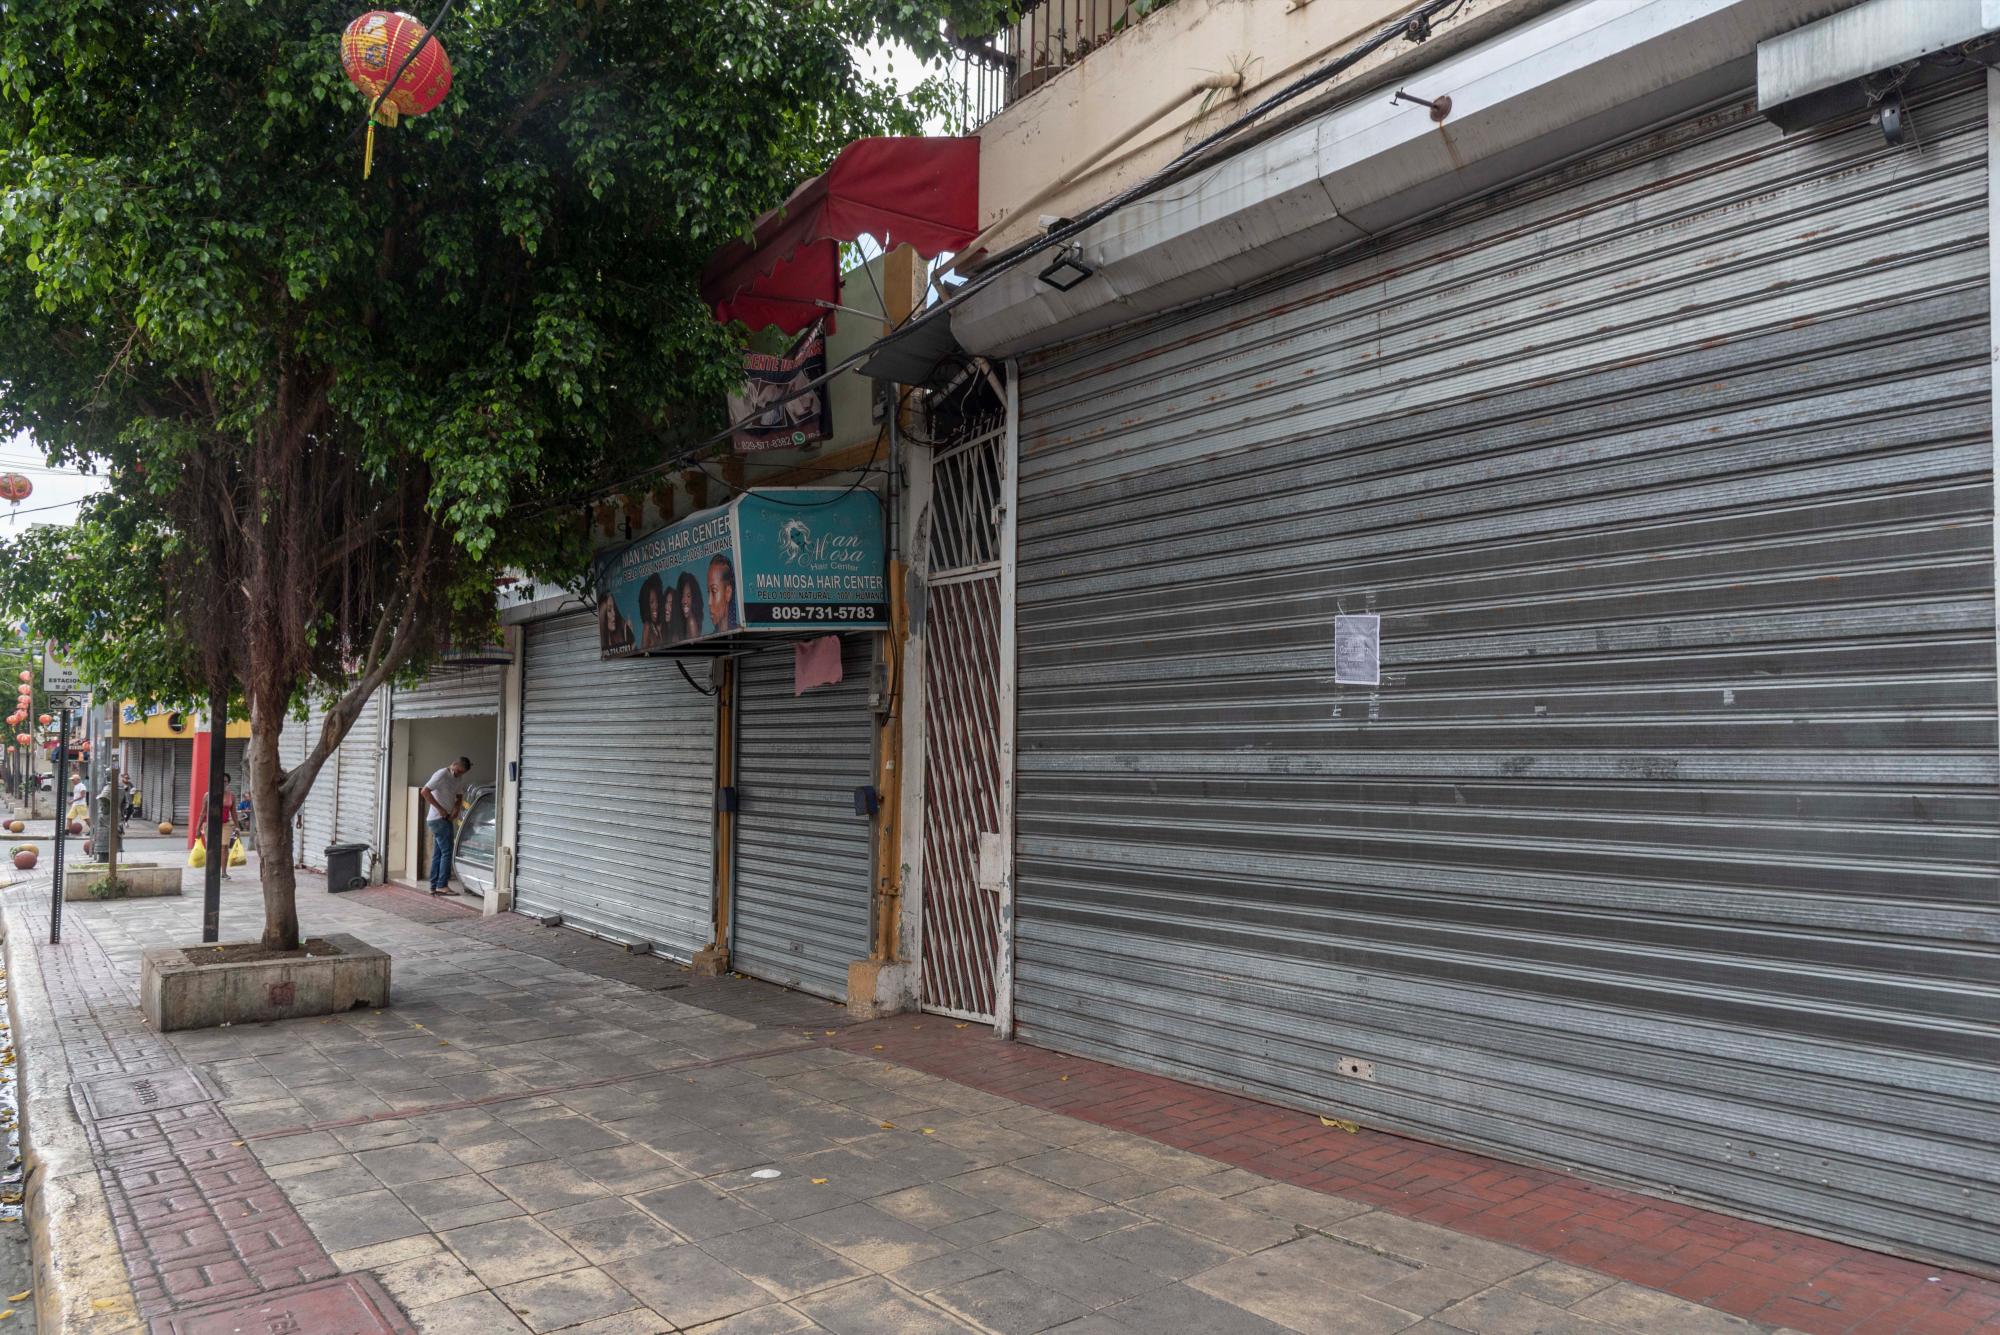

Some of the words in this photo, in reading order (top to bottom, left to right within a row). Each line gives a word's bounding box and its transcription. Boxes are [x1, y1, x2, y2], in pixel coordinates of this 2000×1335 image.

[622, 547, 641, 568] MAN
[642, 540, 668, 561] MOSA
[668, 530, 691, 551] HAIR
[692, 515, 731, 544] CENTER
[810, 562, 828, 571] Hair
[830, 562, 860, 571] Center
[756, 573, 780, 589] MAN
[783, 574, 815, 589] MOSA
[816, 575, 842, 589] HAIR
[843, 575, 884, 590] CENTER
[757, 591, 777, 600] PELO
[799, 591, 831, 600] NATURAL
[771, 606, 875, 620] 809-731-5783
